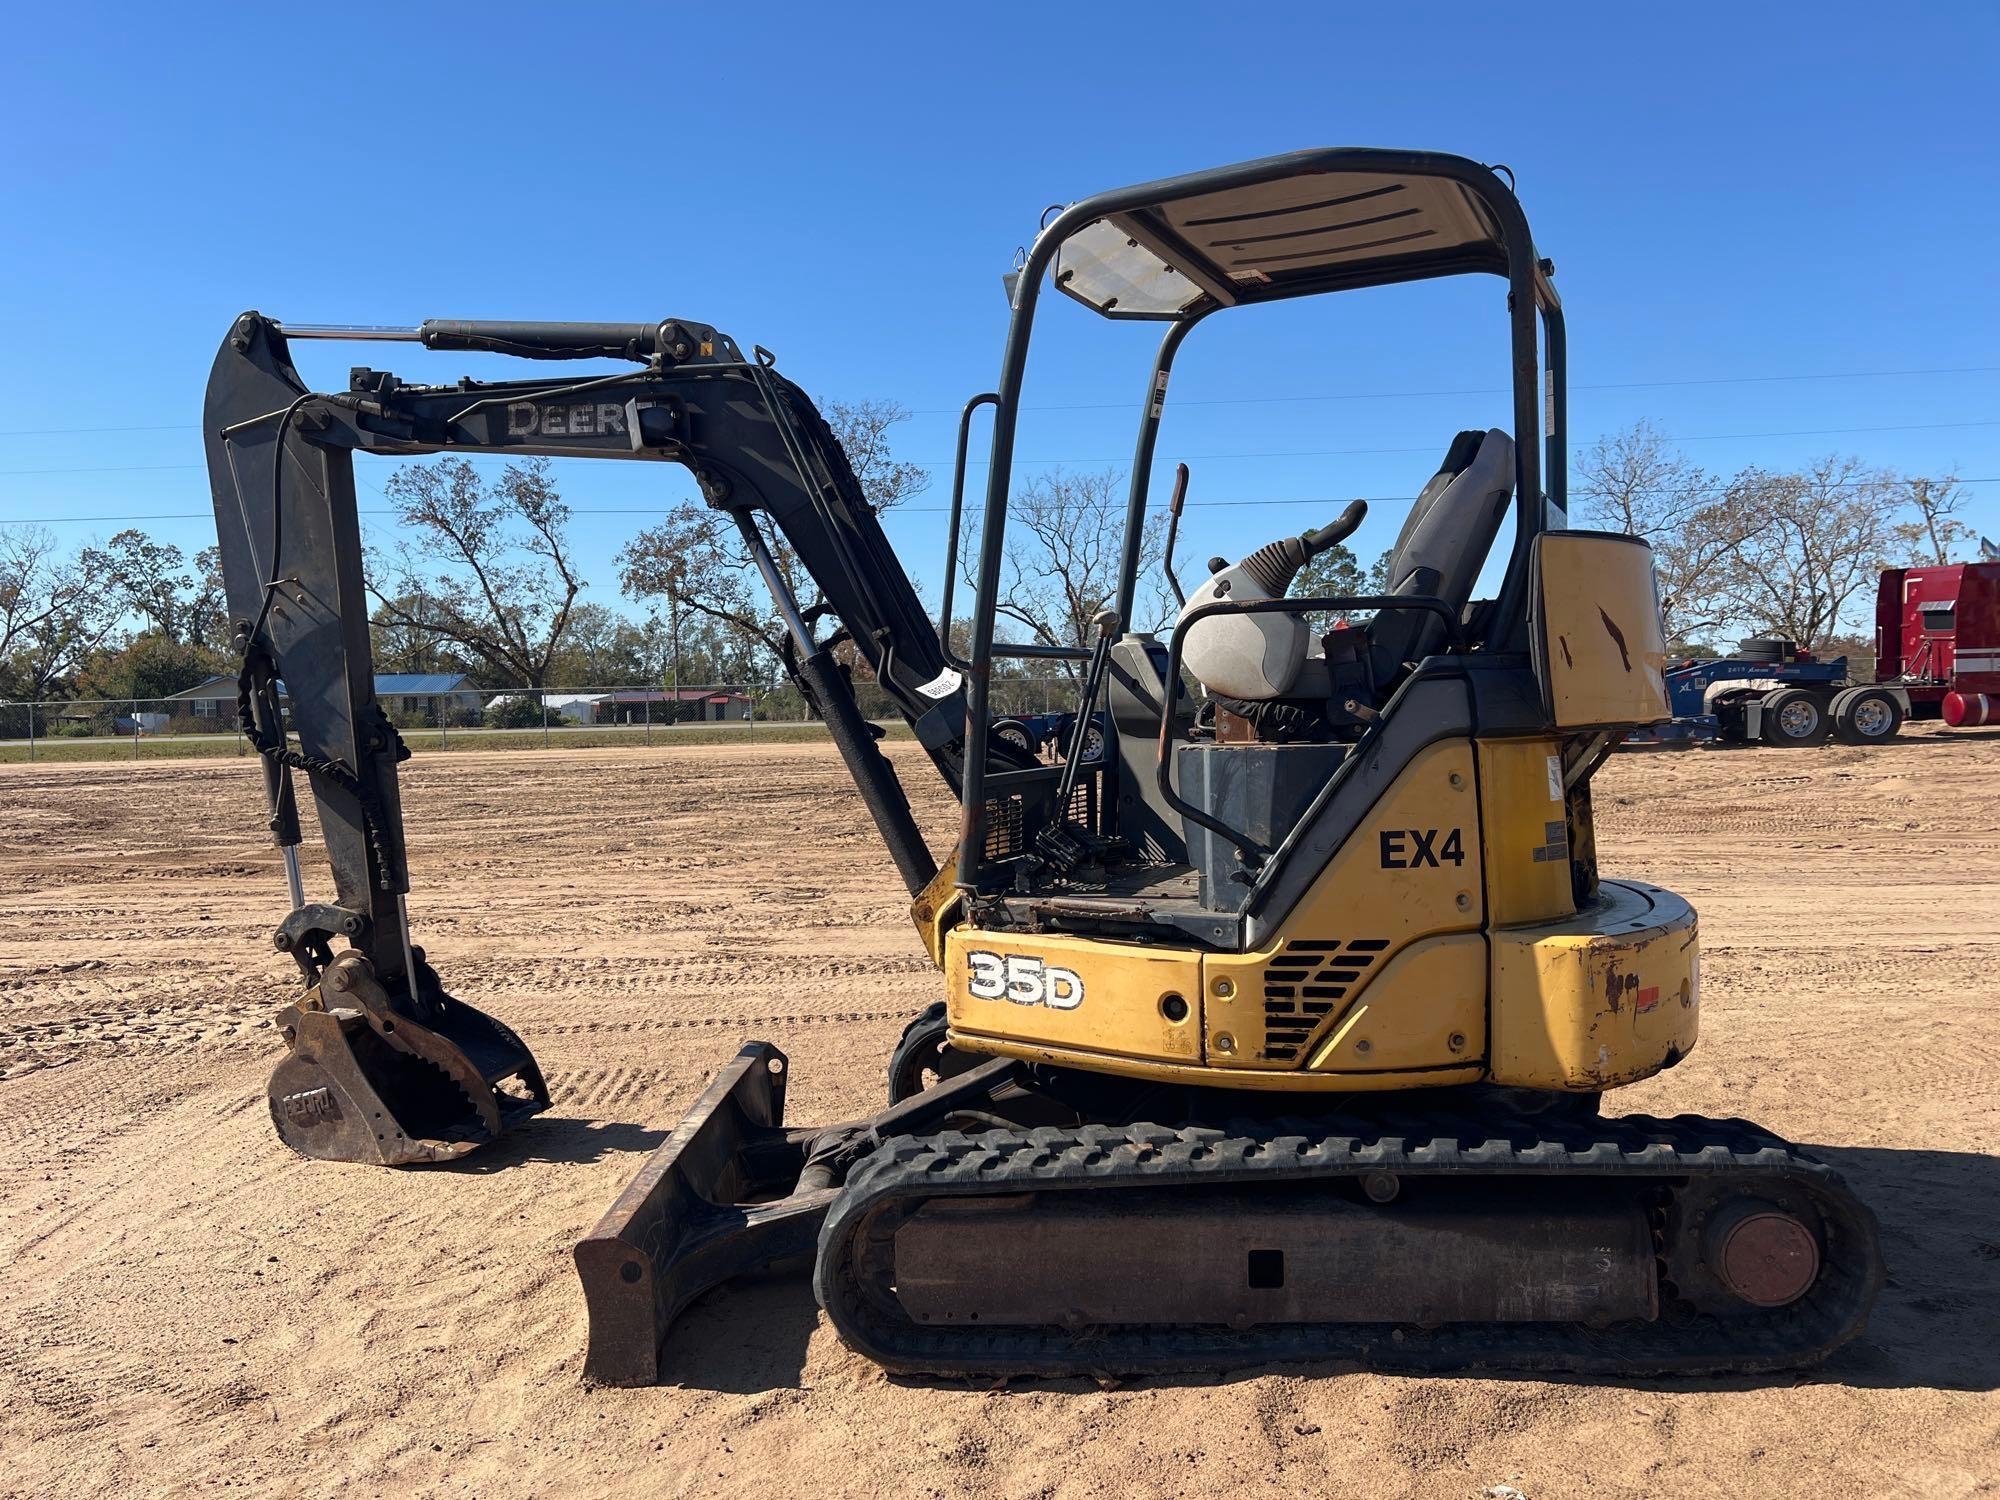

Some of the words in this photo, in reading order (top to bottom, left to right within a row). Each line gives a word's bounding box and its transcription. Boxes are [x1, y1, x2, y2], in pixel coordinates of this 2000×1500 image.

[507, 401, 657, 436] DEER
[1380, 828, 1464, 869] EX4
[967, 950, 1085, 1010] 35D
